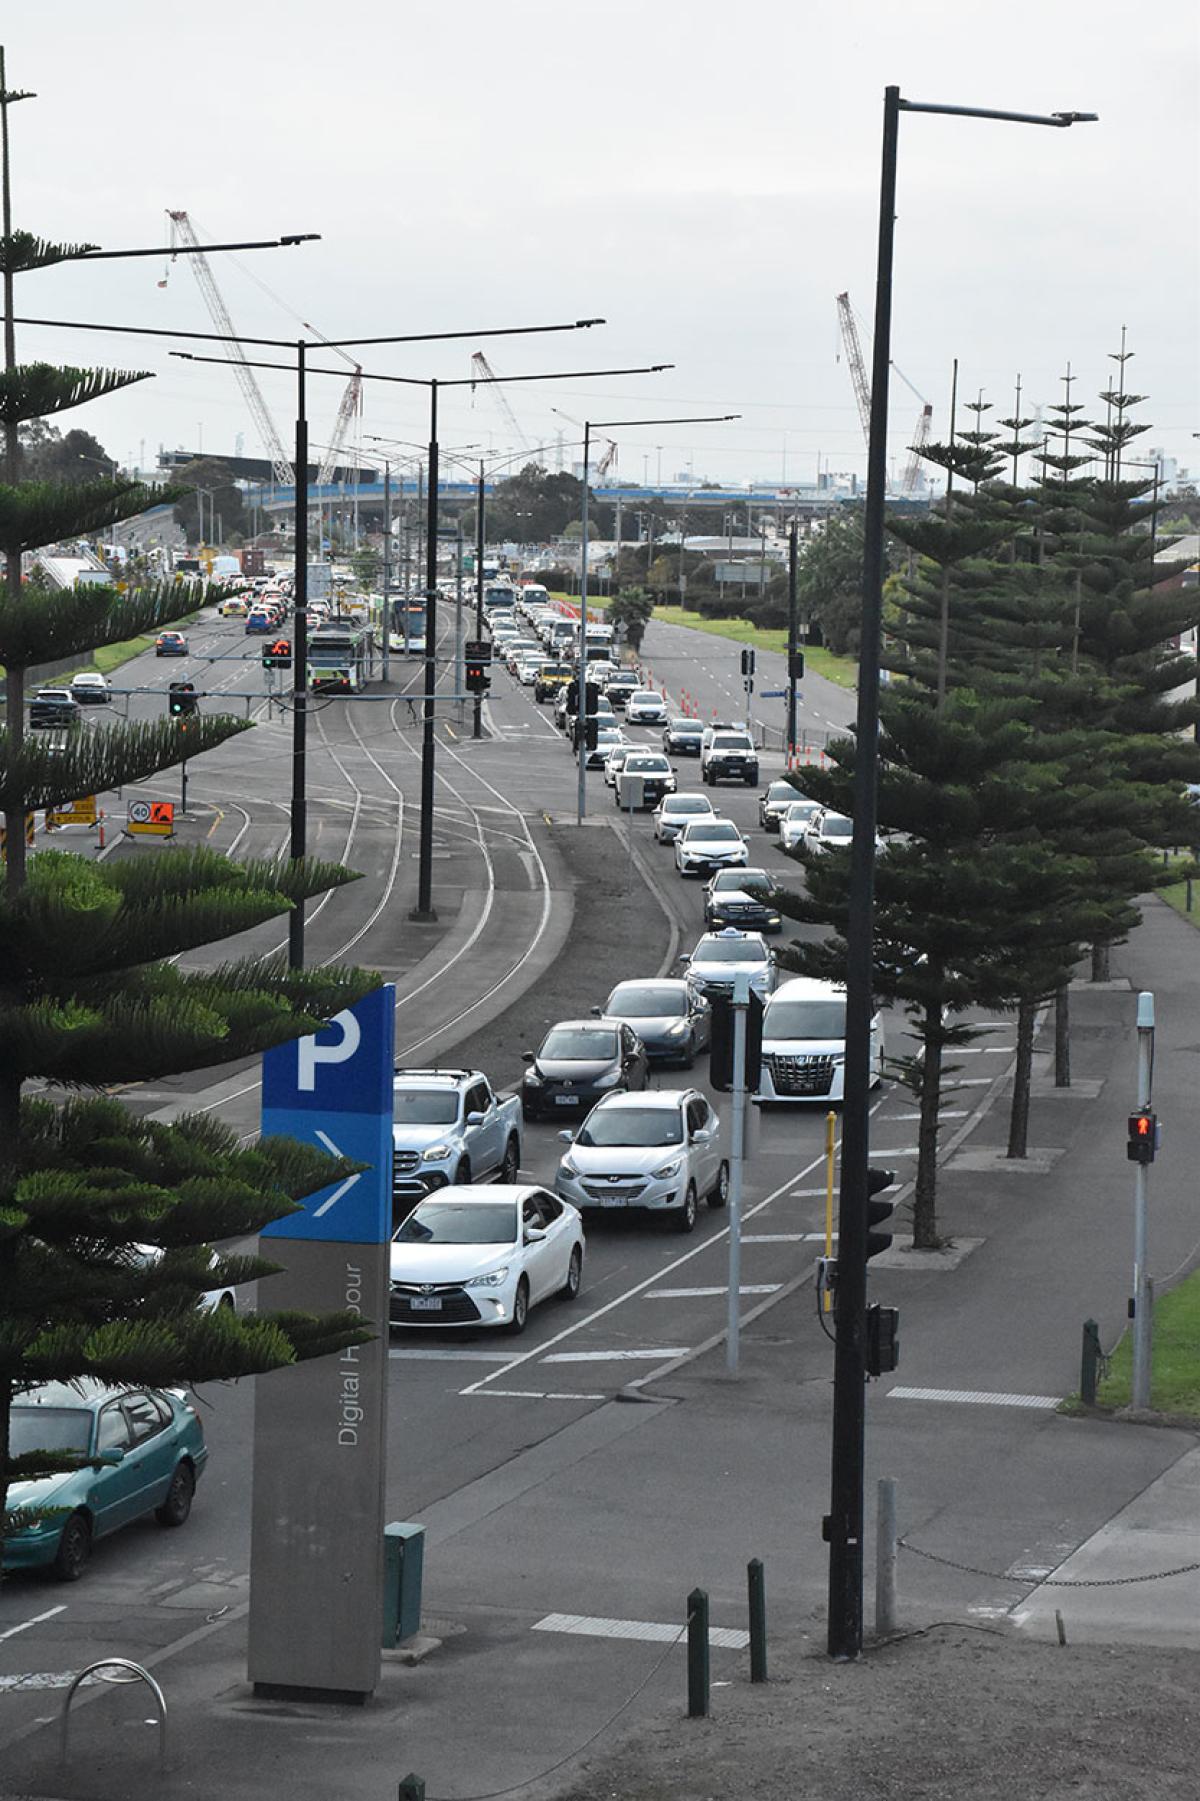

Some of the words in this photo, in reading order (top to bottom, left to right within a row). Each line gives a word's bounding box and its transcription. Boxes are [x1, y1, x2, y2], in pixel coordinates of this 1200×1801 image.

[133, 807, 148, 817] 40
[298, 1008, 360, 1092] P
[338, 1371, 364, 1446] Digital
